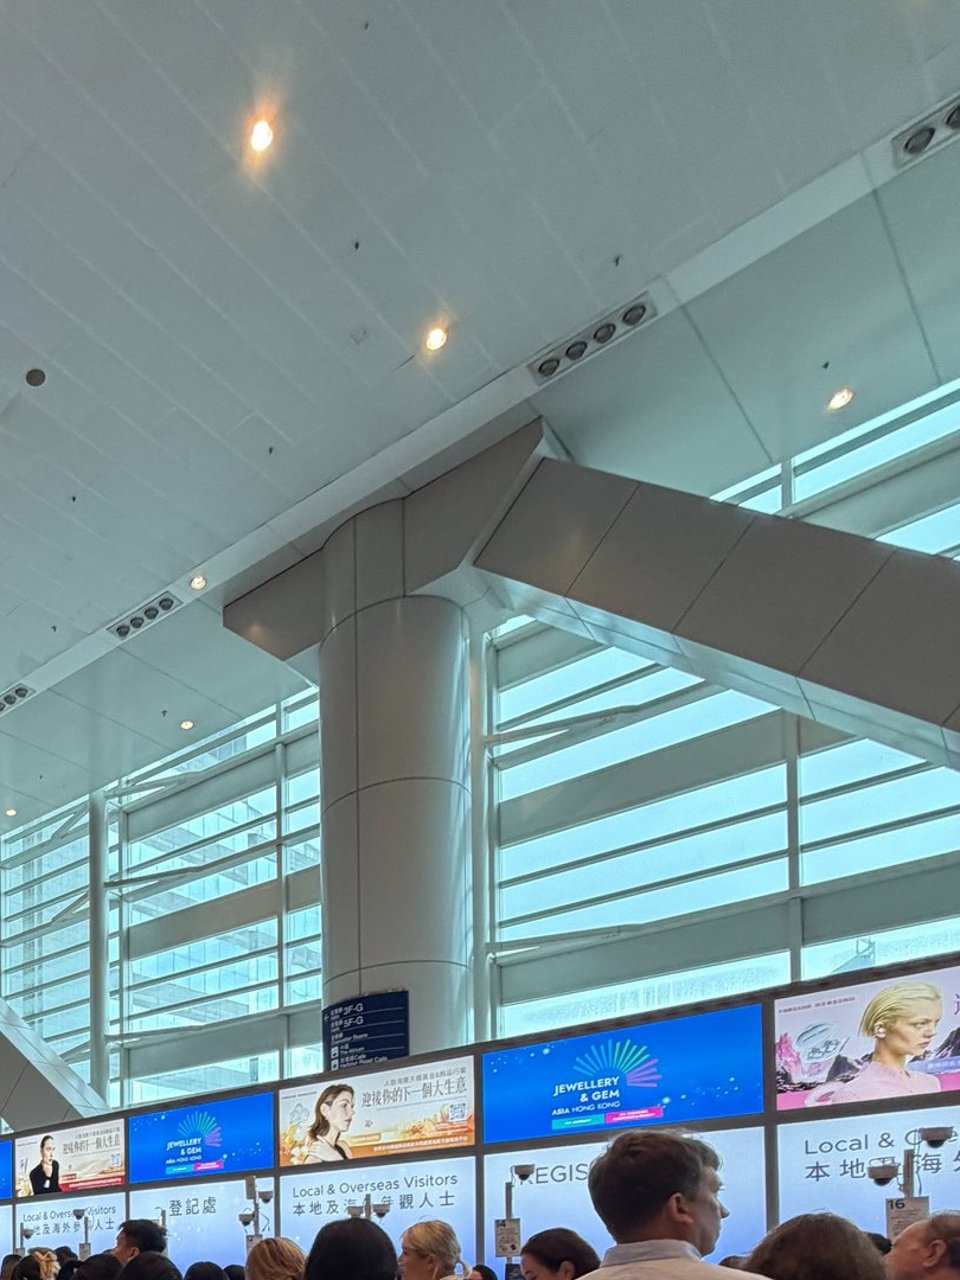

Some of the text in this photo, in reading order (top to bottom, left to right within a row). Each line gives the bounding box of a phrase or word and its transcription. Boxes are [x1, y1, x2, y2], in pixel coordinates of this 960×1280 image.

[343, 1003, 364, 1016] 3F-G
[343, 1016, 364, 1028] 5F-G
[553, 1076, 620, 1097] JEWELLERY
[580, 1089, 620, 1103] & GEM
[551, 1100, 621, 1116] ASIA HONG KONG
[166, 1137, 202, 1151] JEWELLERY
[187, 1146, 202, 1155] GEM
[804, 1134, 868, 1155] Local
[878, 1132, 895, 1149] &
[292, 1174, 458, 1198] Local & Overseas Visitors
[169, 1196, 217, 1217] 登記處
[23, 1211, 41, 1222] Local
[43, 1211, 48, 1220] &
